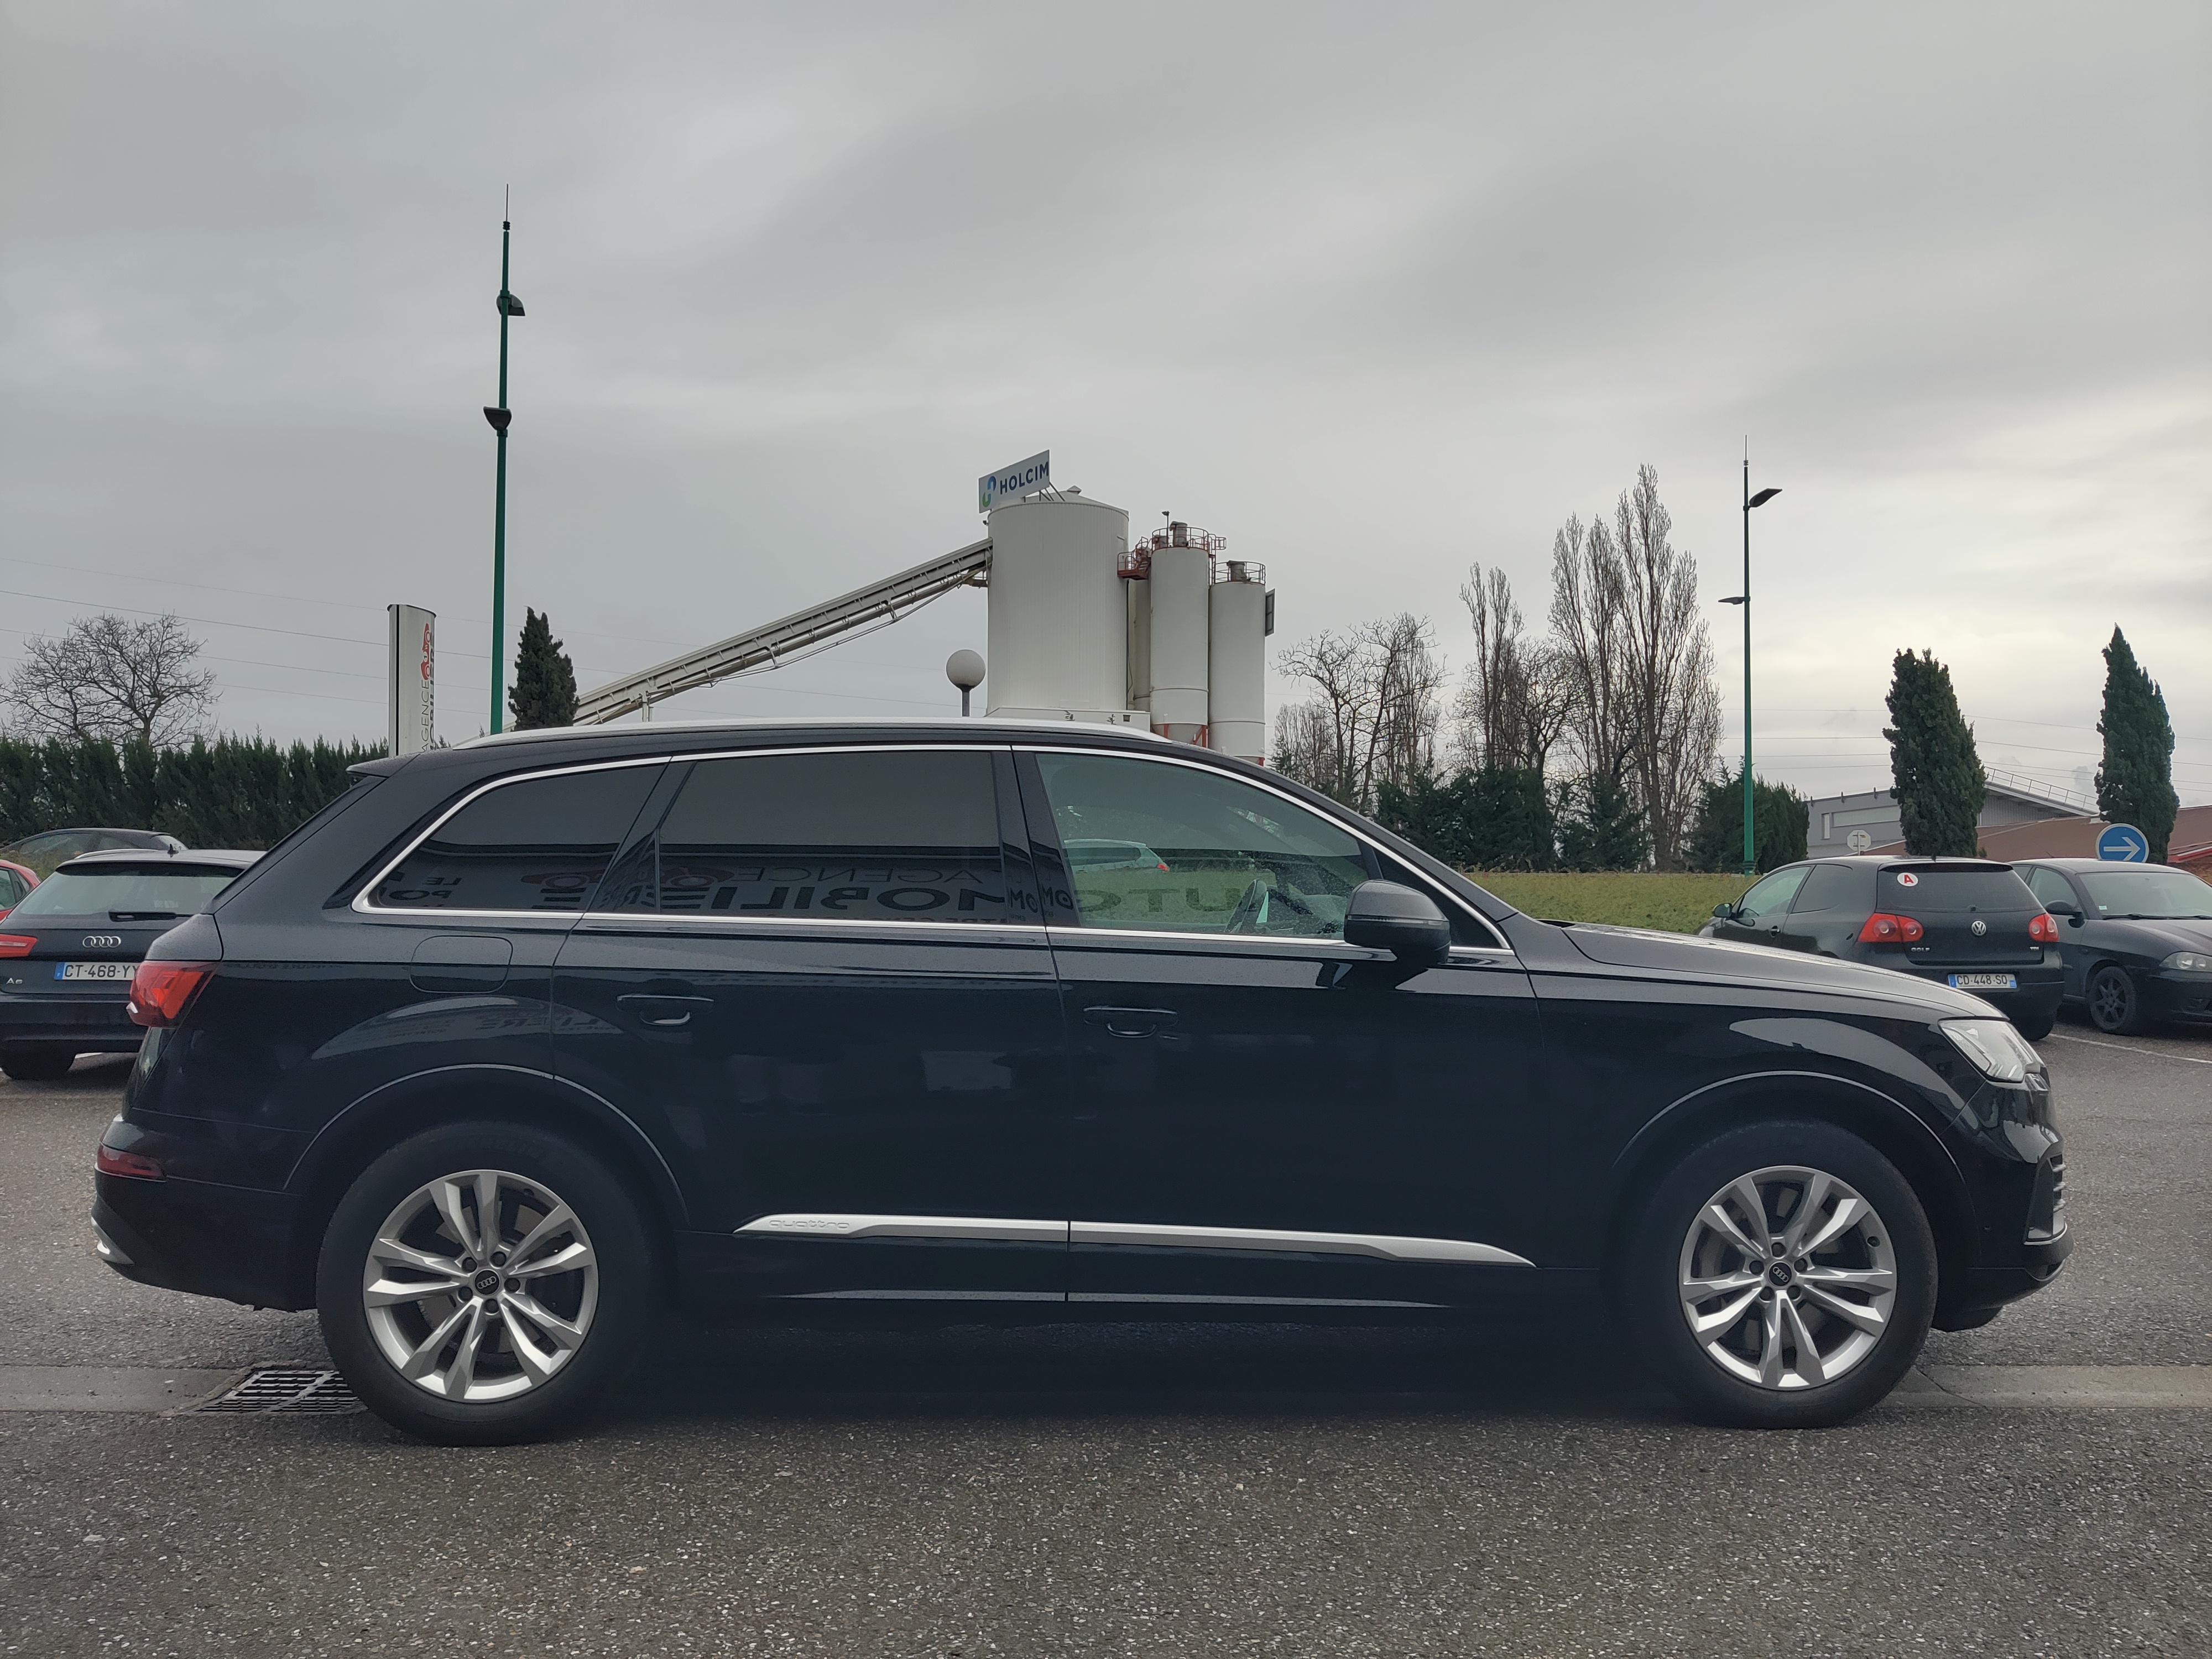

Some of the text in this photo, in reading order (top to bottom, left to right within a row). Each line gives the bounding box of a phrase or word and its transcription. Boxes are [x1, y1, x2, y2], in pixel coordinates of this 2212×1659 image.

[1000, 461, 1049, 495] HOLCIM
[421, 679, 429, 752] AGENCE
[1903, 874, 1914, 884] A
[769, 1219, 850, 1229] quattro
